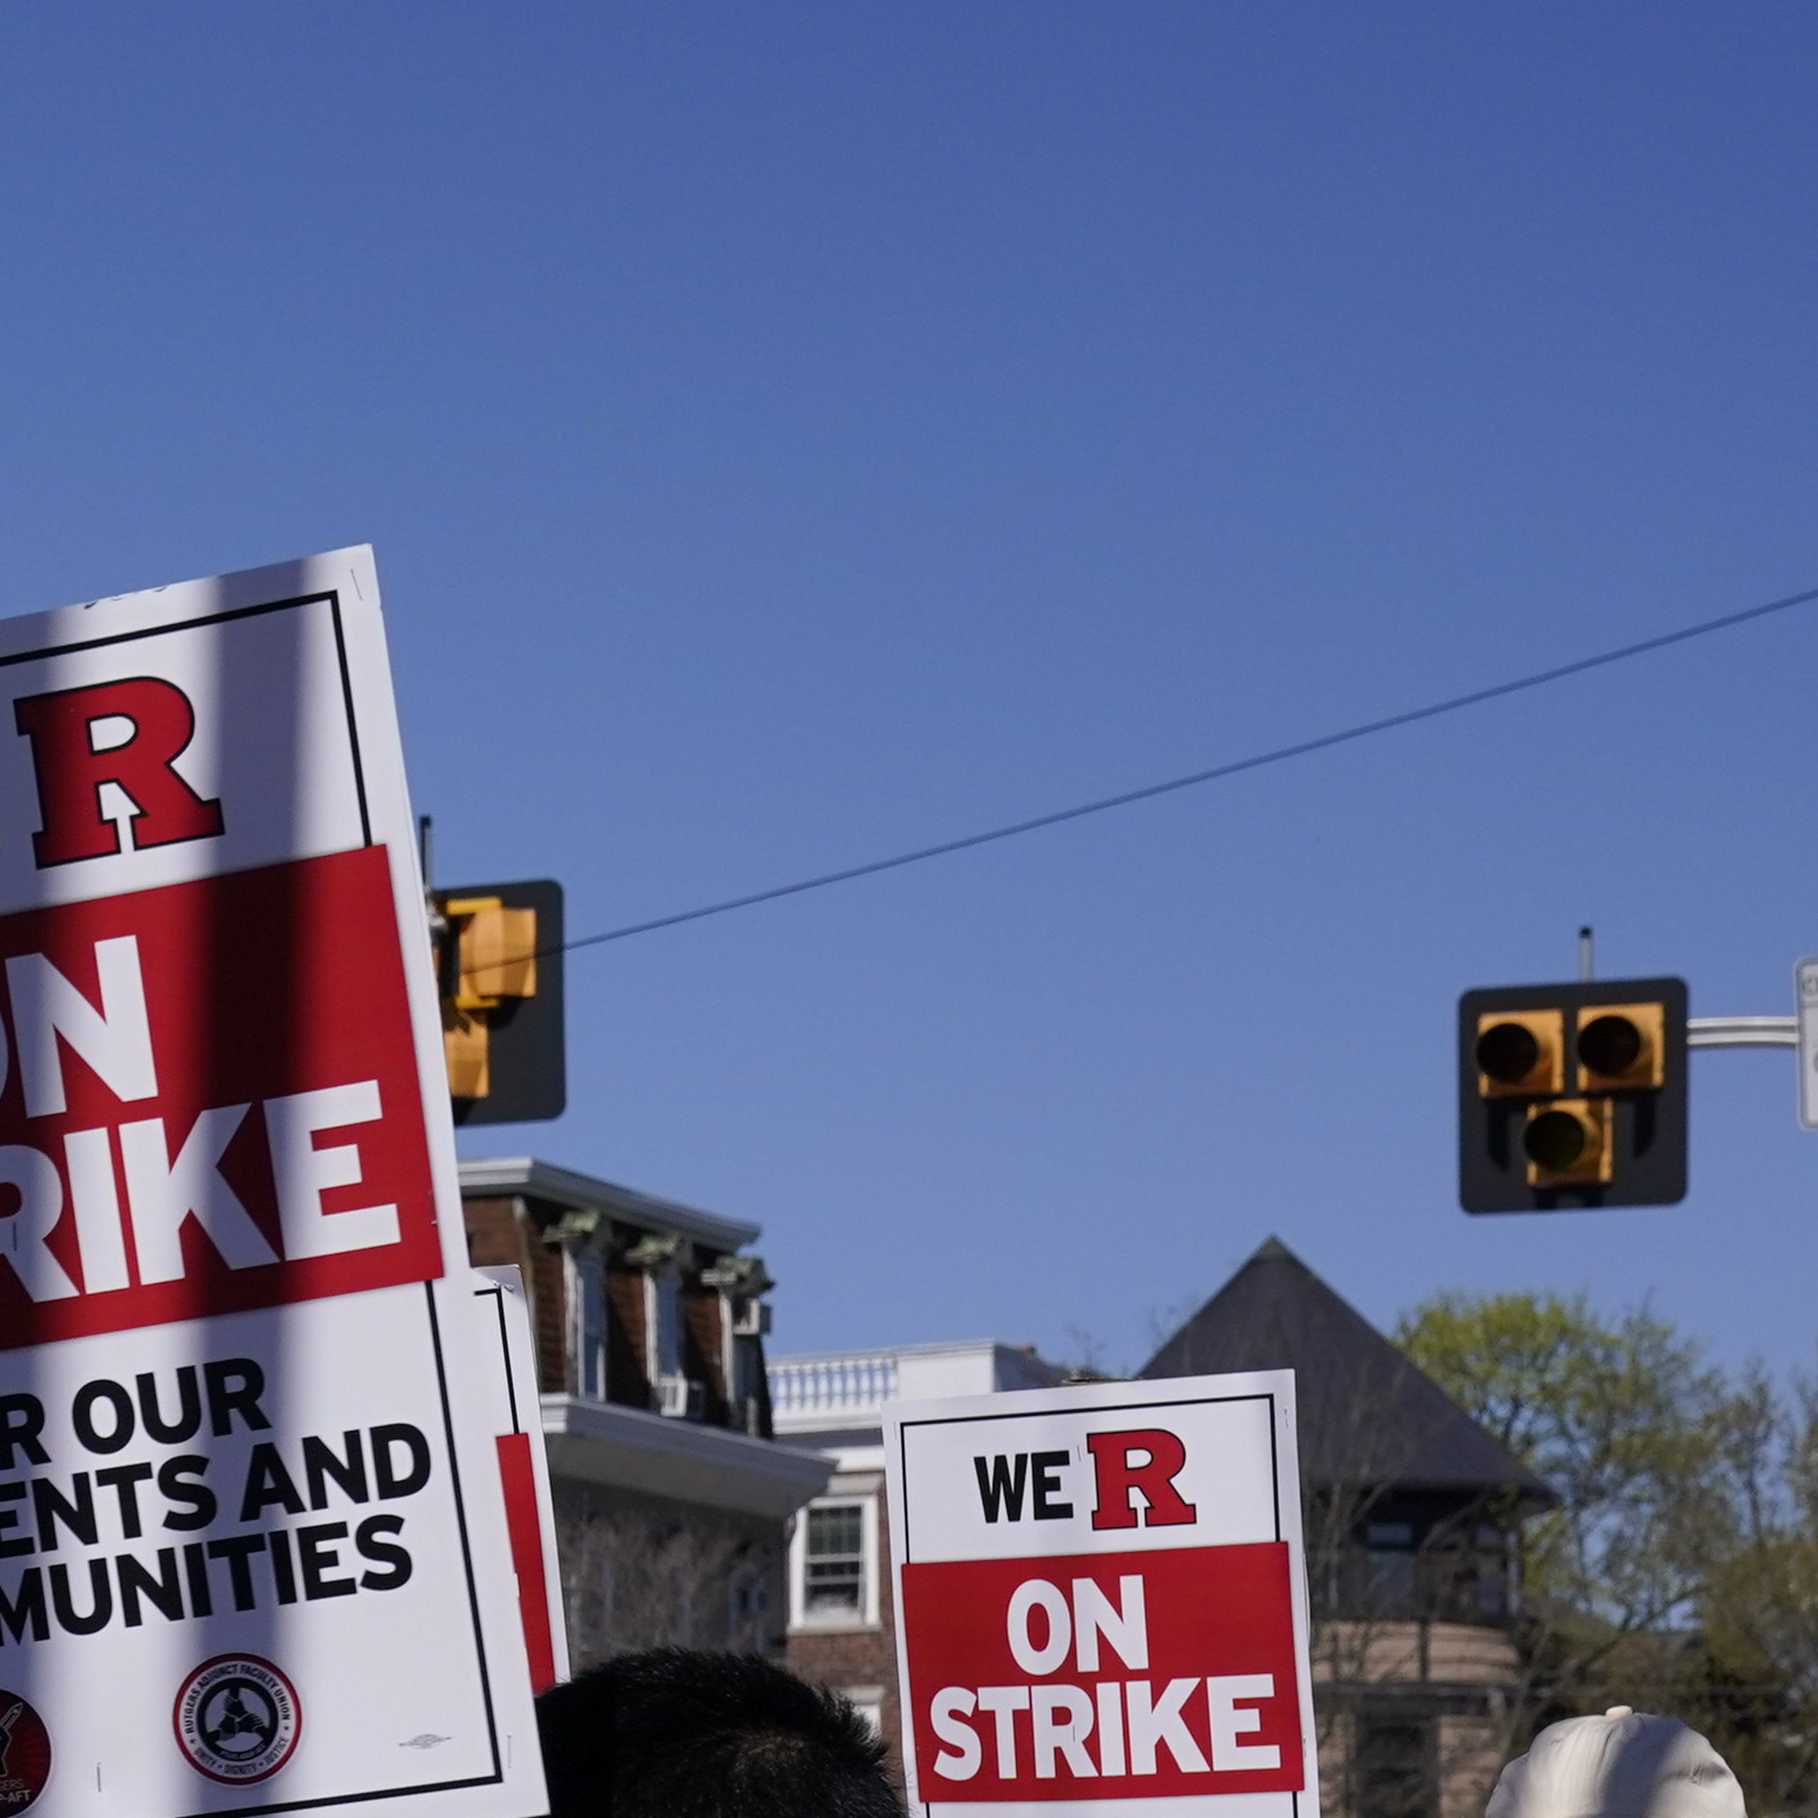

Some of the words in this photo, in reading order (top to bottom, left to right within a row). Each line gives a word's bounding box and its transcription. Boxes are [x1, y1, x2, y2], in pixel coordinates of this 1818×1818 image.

[15, 675, 223, 870] R
[72, 1357, 268, 1442] OUR
[238, 1421, 432, 1521] AND
[973, 1450, 1074, 1523] WE
[1087, 1428, 1197, 1530] R
[1007, 1574, 1149, 1676] ON
[930, 1673, 1282, 1781] STRIKE
